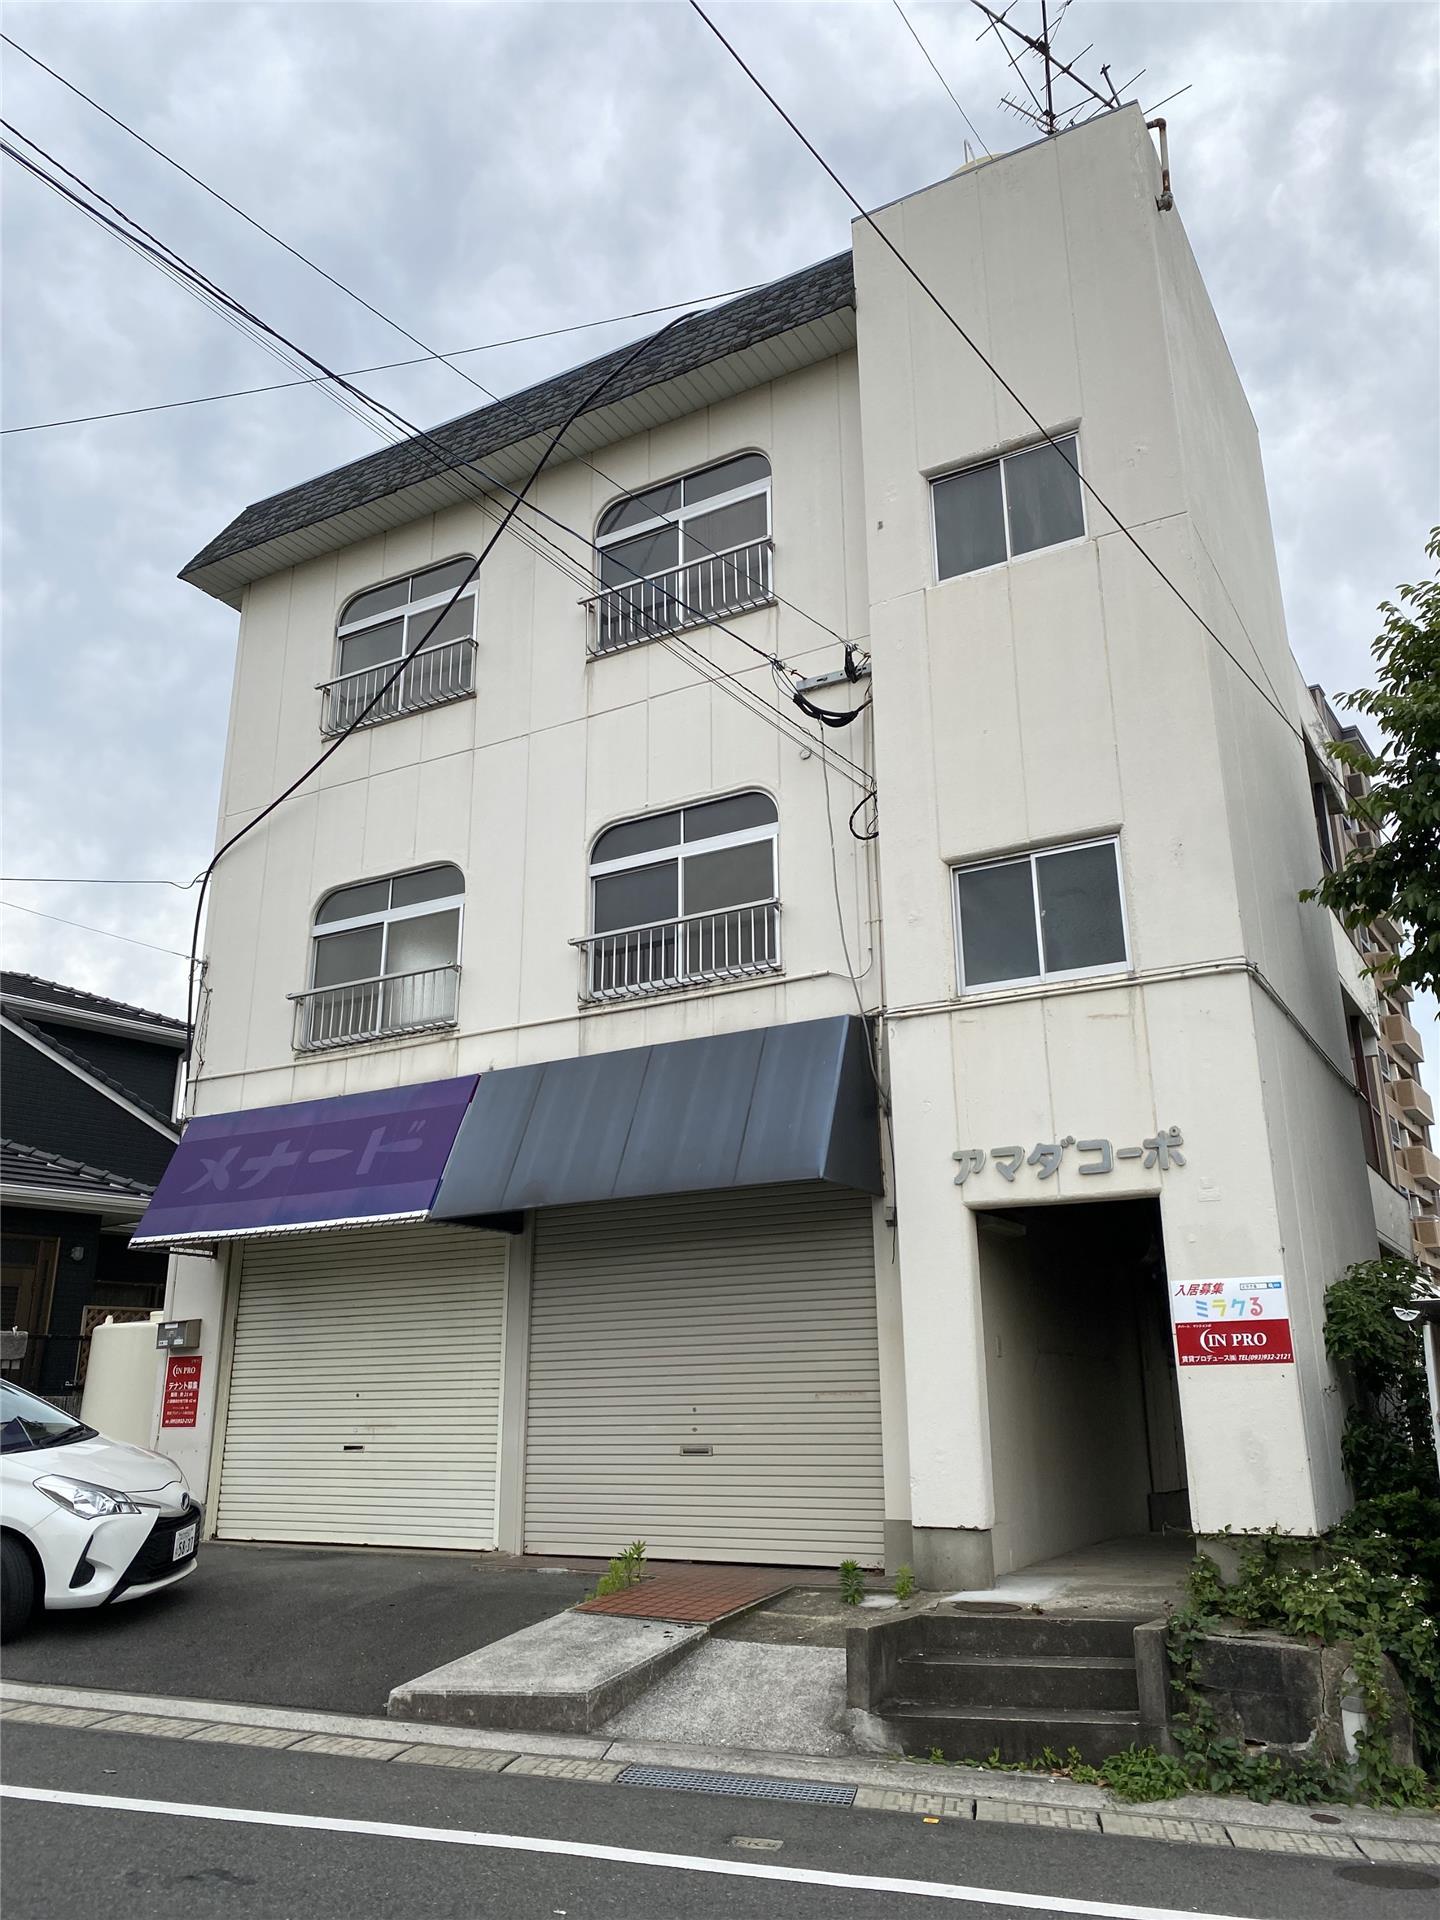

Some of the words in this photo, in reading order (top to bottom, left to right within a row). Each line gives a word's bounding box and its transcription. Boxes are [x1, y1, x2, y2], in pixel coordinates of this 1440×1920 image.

[181, 1119, 427, 1194] メナード
[952, 1125, 1187, 1185] アマダコーポ
[1175, 1282, 1224, 1296] 入居募集
[1195, 1296, 1263, 1318] ミラクる
[1207, 1333, 1227, 1347] IN
[1231, 1332, 1267, 1347] PRO
[184, 1366, 196, 1374] PRO
[168, 1381, 198, 1390] テナント募集
